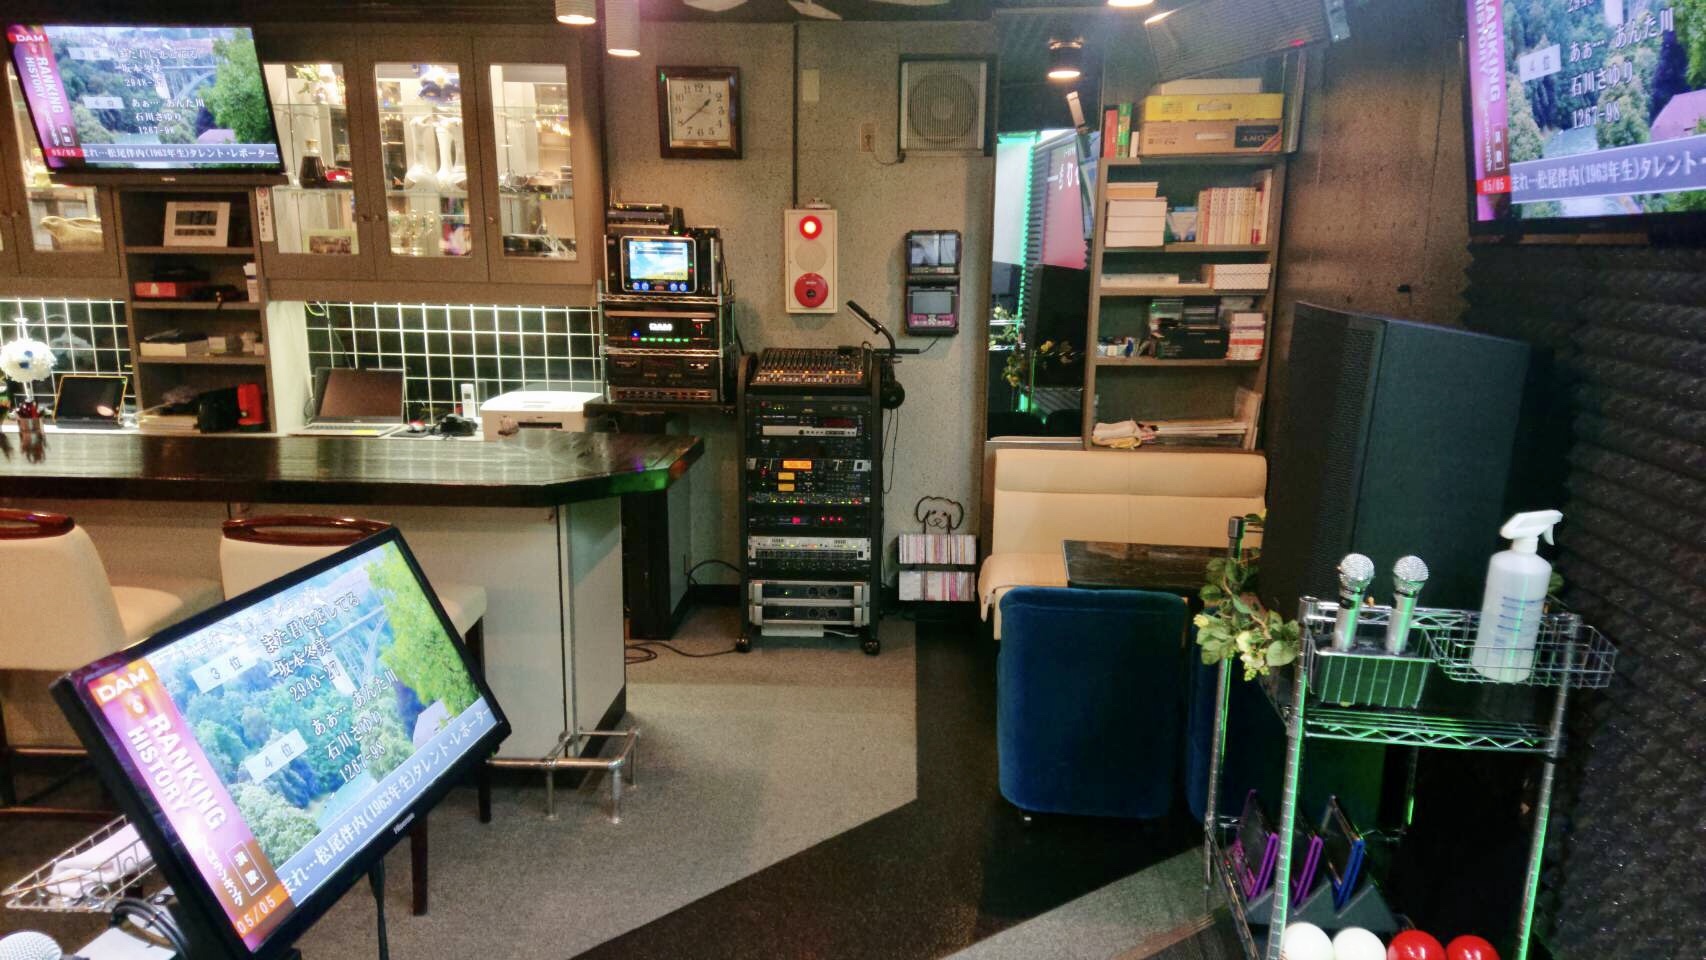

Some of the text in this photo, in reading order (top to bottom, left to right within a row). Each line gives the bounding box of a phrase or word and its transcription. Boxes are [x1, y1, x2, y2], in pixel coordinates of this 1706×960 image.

[15, 34, 45, 42] DAM
[1615, 7, 1673, 48] あんた川
[1486, 0, 1500, 101] ANKING
[25, 57, 45, 97] HISTORY
[37, 57, 64, 113] RANKING
[1572, 60, 1633, 96] 石川さゆり
[1573, 102, 1620, 129] 1267-98
[258, 588, 362, 655] また君に恋してる
[273, 634, 332, 679] 坂本冬美
[95, 666, 151, 703] DAM
[287, 659, 343, 703] 2948-27
[350, 666, 399, 709] あんた川
[322, 708, 385, 762] 石川さゆり
[126, 723, 190, 815] HISTORY
[145, 712, 229, 832] RANKING
[337, 738, 387, 785] 1267-98
[235, 892, 278, 936] 05/05
